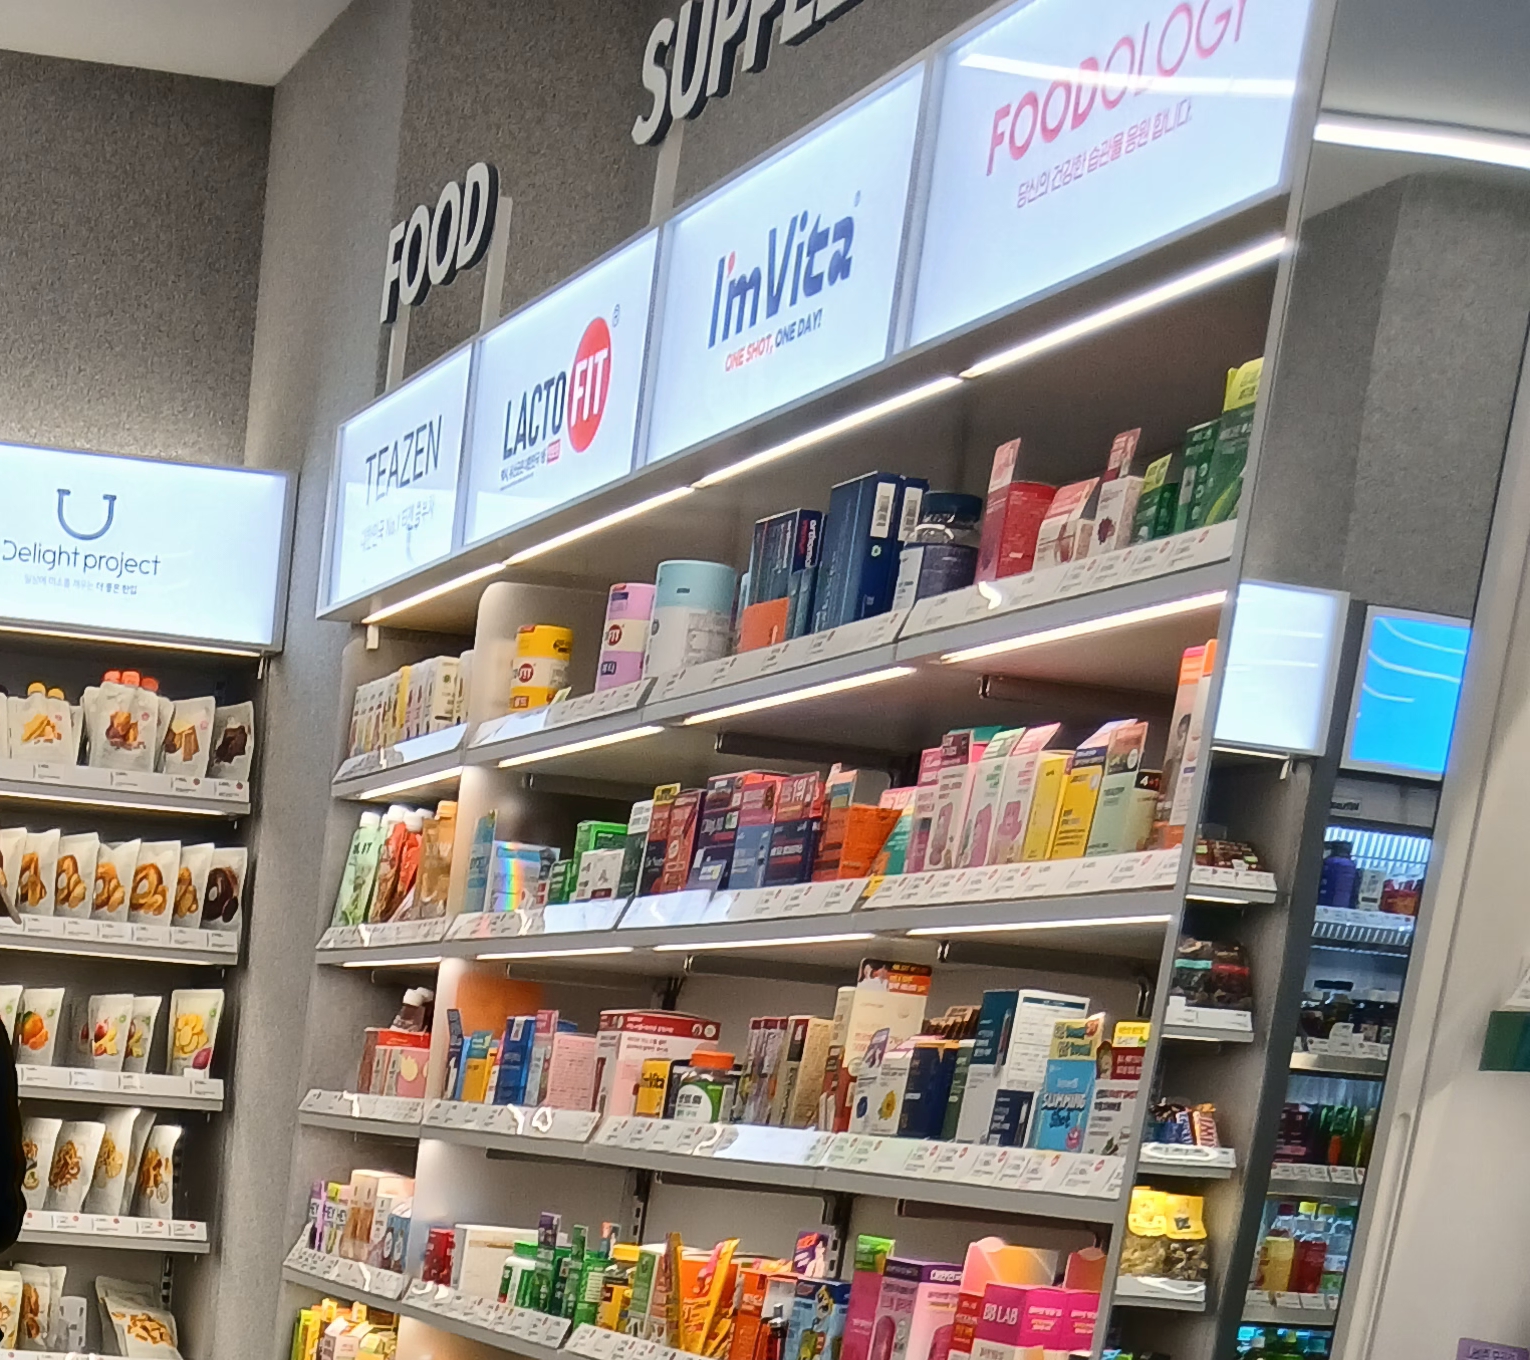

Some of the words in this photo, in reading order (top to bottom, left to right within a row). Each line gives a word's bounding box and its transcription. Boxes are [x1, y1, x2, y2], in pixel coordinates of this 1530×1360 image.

[631, 0, 855, 145] SUPP
[1016, 170, 1051, 209] 당신의
[1051, 150, 1087, 192] 건강한
[1087, 131, 1125, 174] 습관을
[1124, 117, 1152, 154] 응원
[380, 162, 496, 324] FOOD
[724, 346, 745, 372] ONE
[774, 320, 797, 349] ONE
[797, 307, 823, 339] DAY!
[503, 370, 567, 461] LACTO
[570, 347, 609, 428] FIT
[365, 414, 443, 506] TEAZEN
[2, 538, 81, 571] Delight
[82, 551, 162, 578] project
[996, 1304, 1019, 1326] LAB
